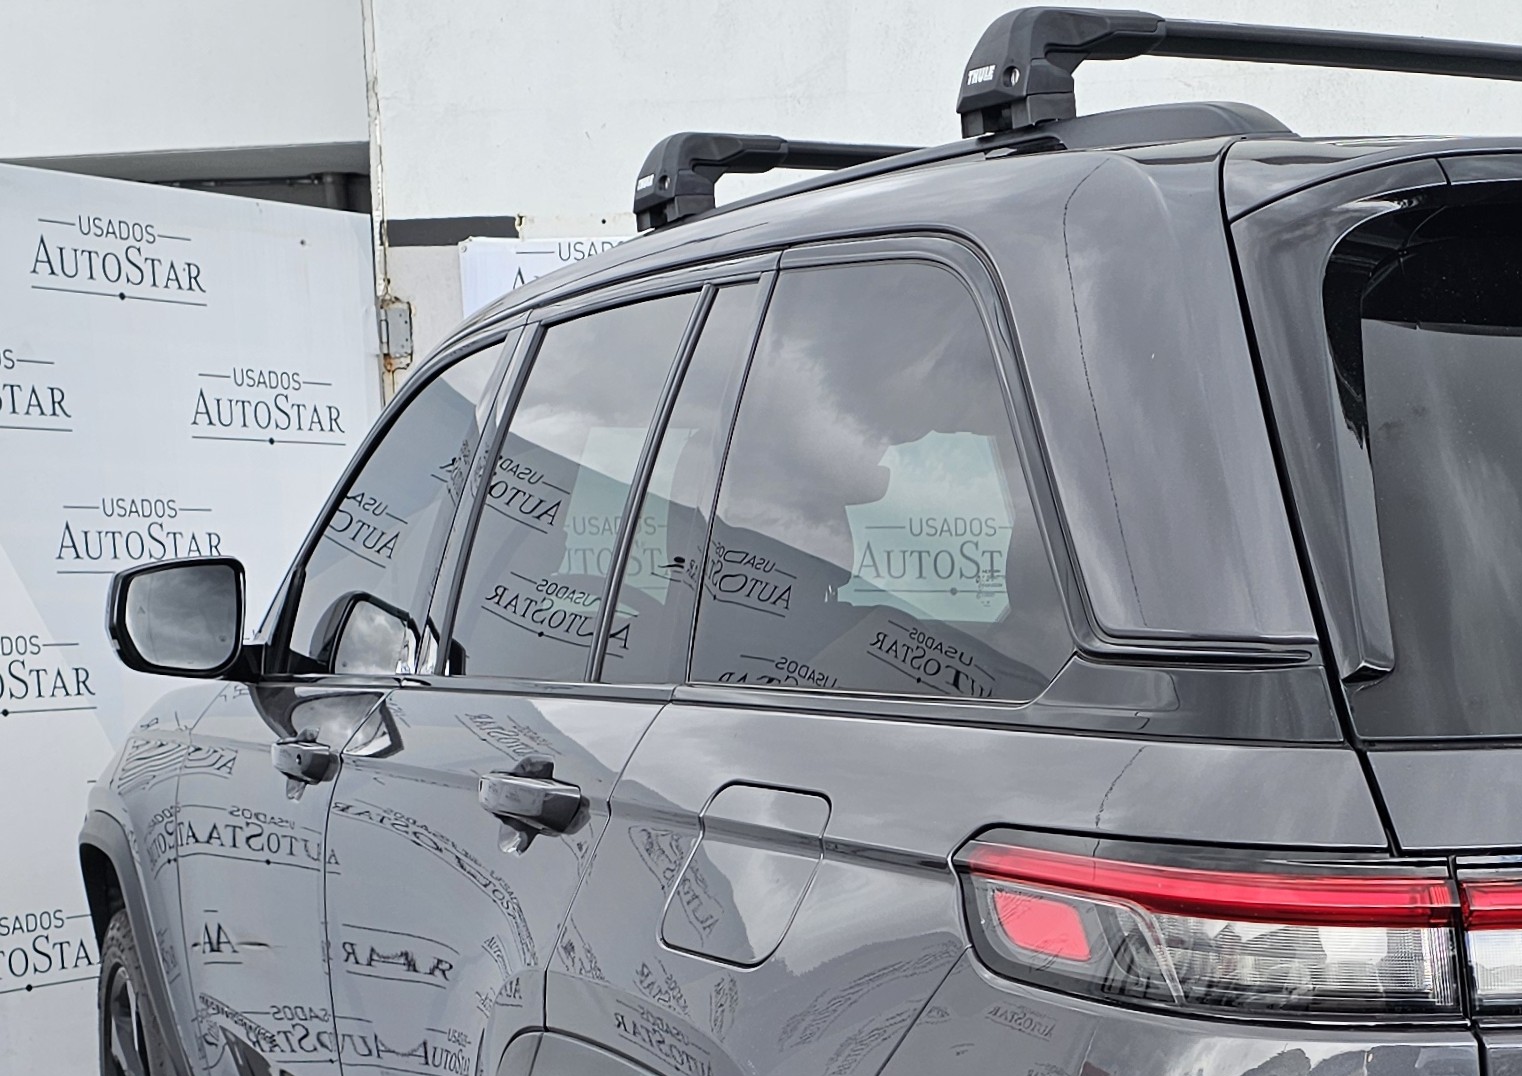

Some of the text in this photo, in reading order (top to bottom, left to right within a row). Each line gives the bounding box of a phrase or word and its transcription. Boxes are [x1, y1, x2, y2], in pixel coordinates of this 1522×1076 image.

[78, 214, 157, 244] USADOS
[30, 234, 206, 293] AUTOSTAR
[233, 368, 302, 391] USADOS
[191, 388, 346, 434] AUTOSTAR
[102, 498, 178, 519] USADOS
[909, 517, 997, 537] USADOS
[0, 659, 97, 699] STAR
